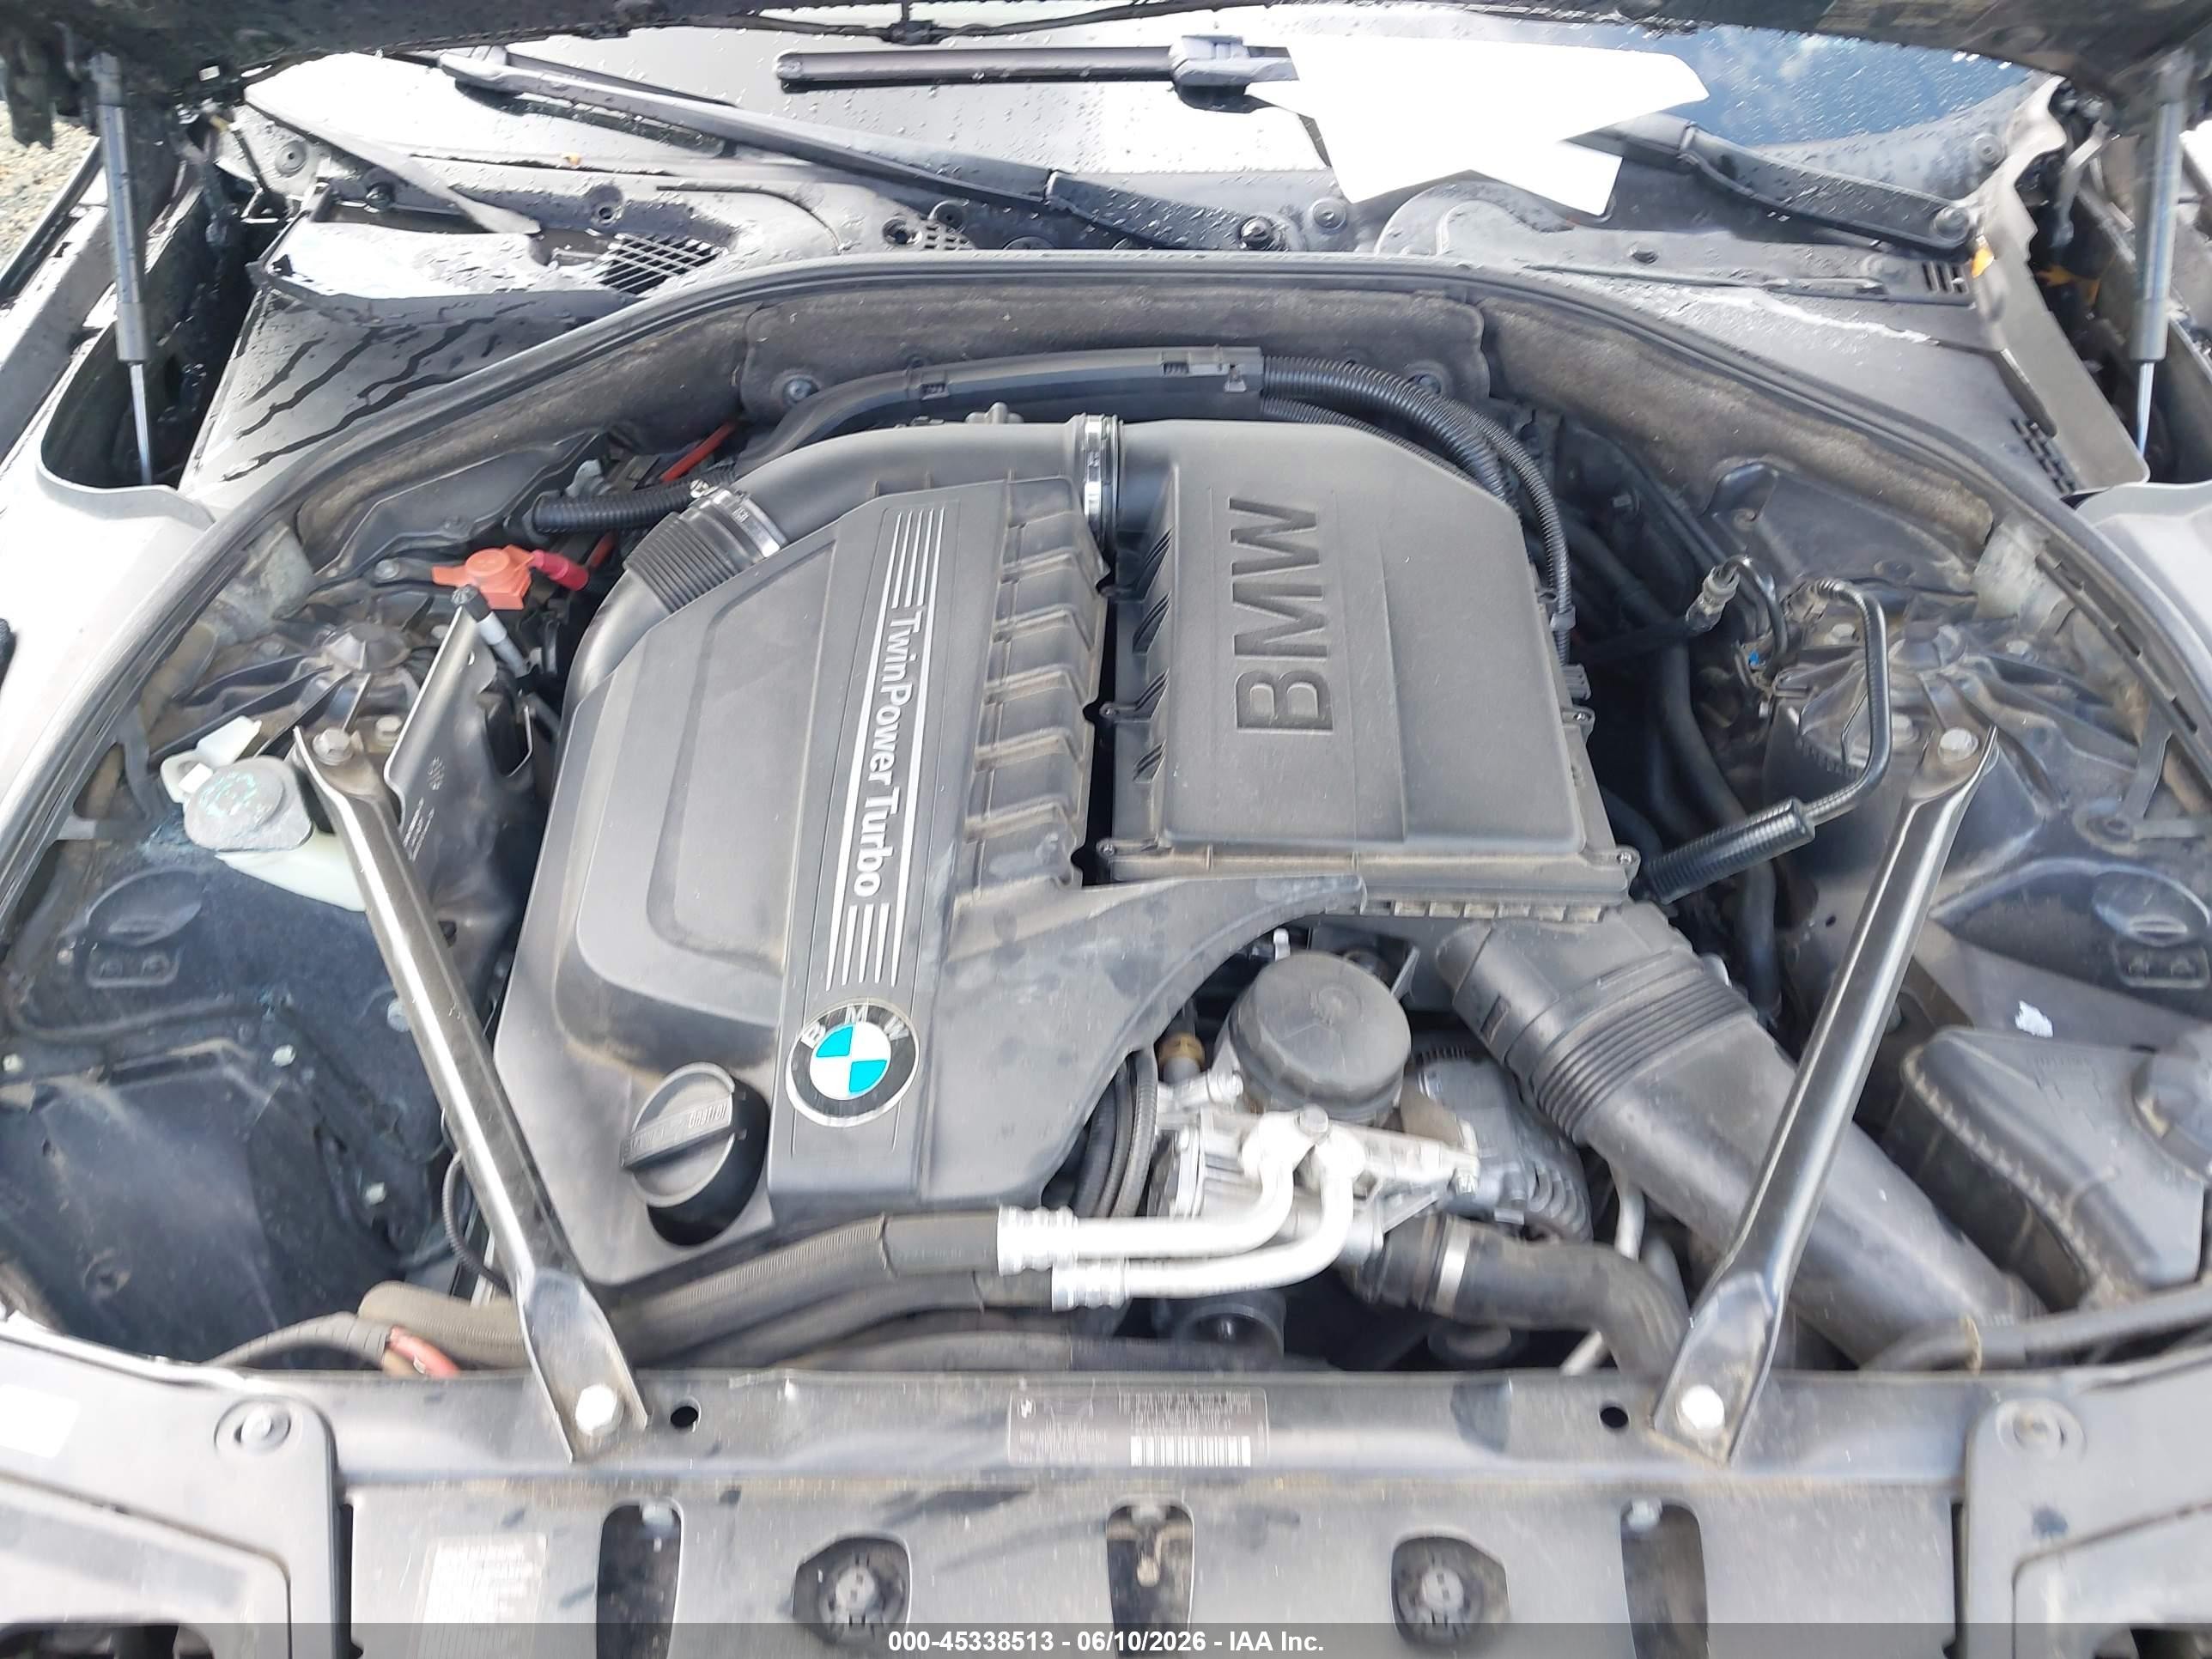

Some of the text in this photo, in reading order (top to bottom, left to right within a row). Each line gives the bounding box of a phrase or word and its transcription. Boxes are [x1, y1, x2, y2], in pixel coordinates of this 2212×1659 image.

[1228, 495, 1334, 735] BMW
[854, 610, 922, 897] TwinPower Turbo
[799, 1003, 910, 1049] BMW
